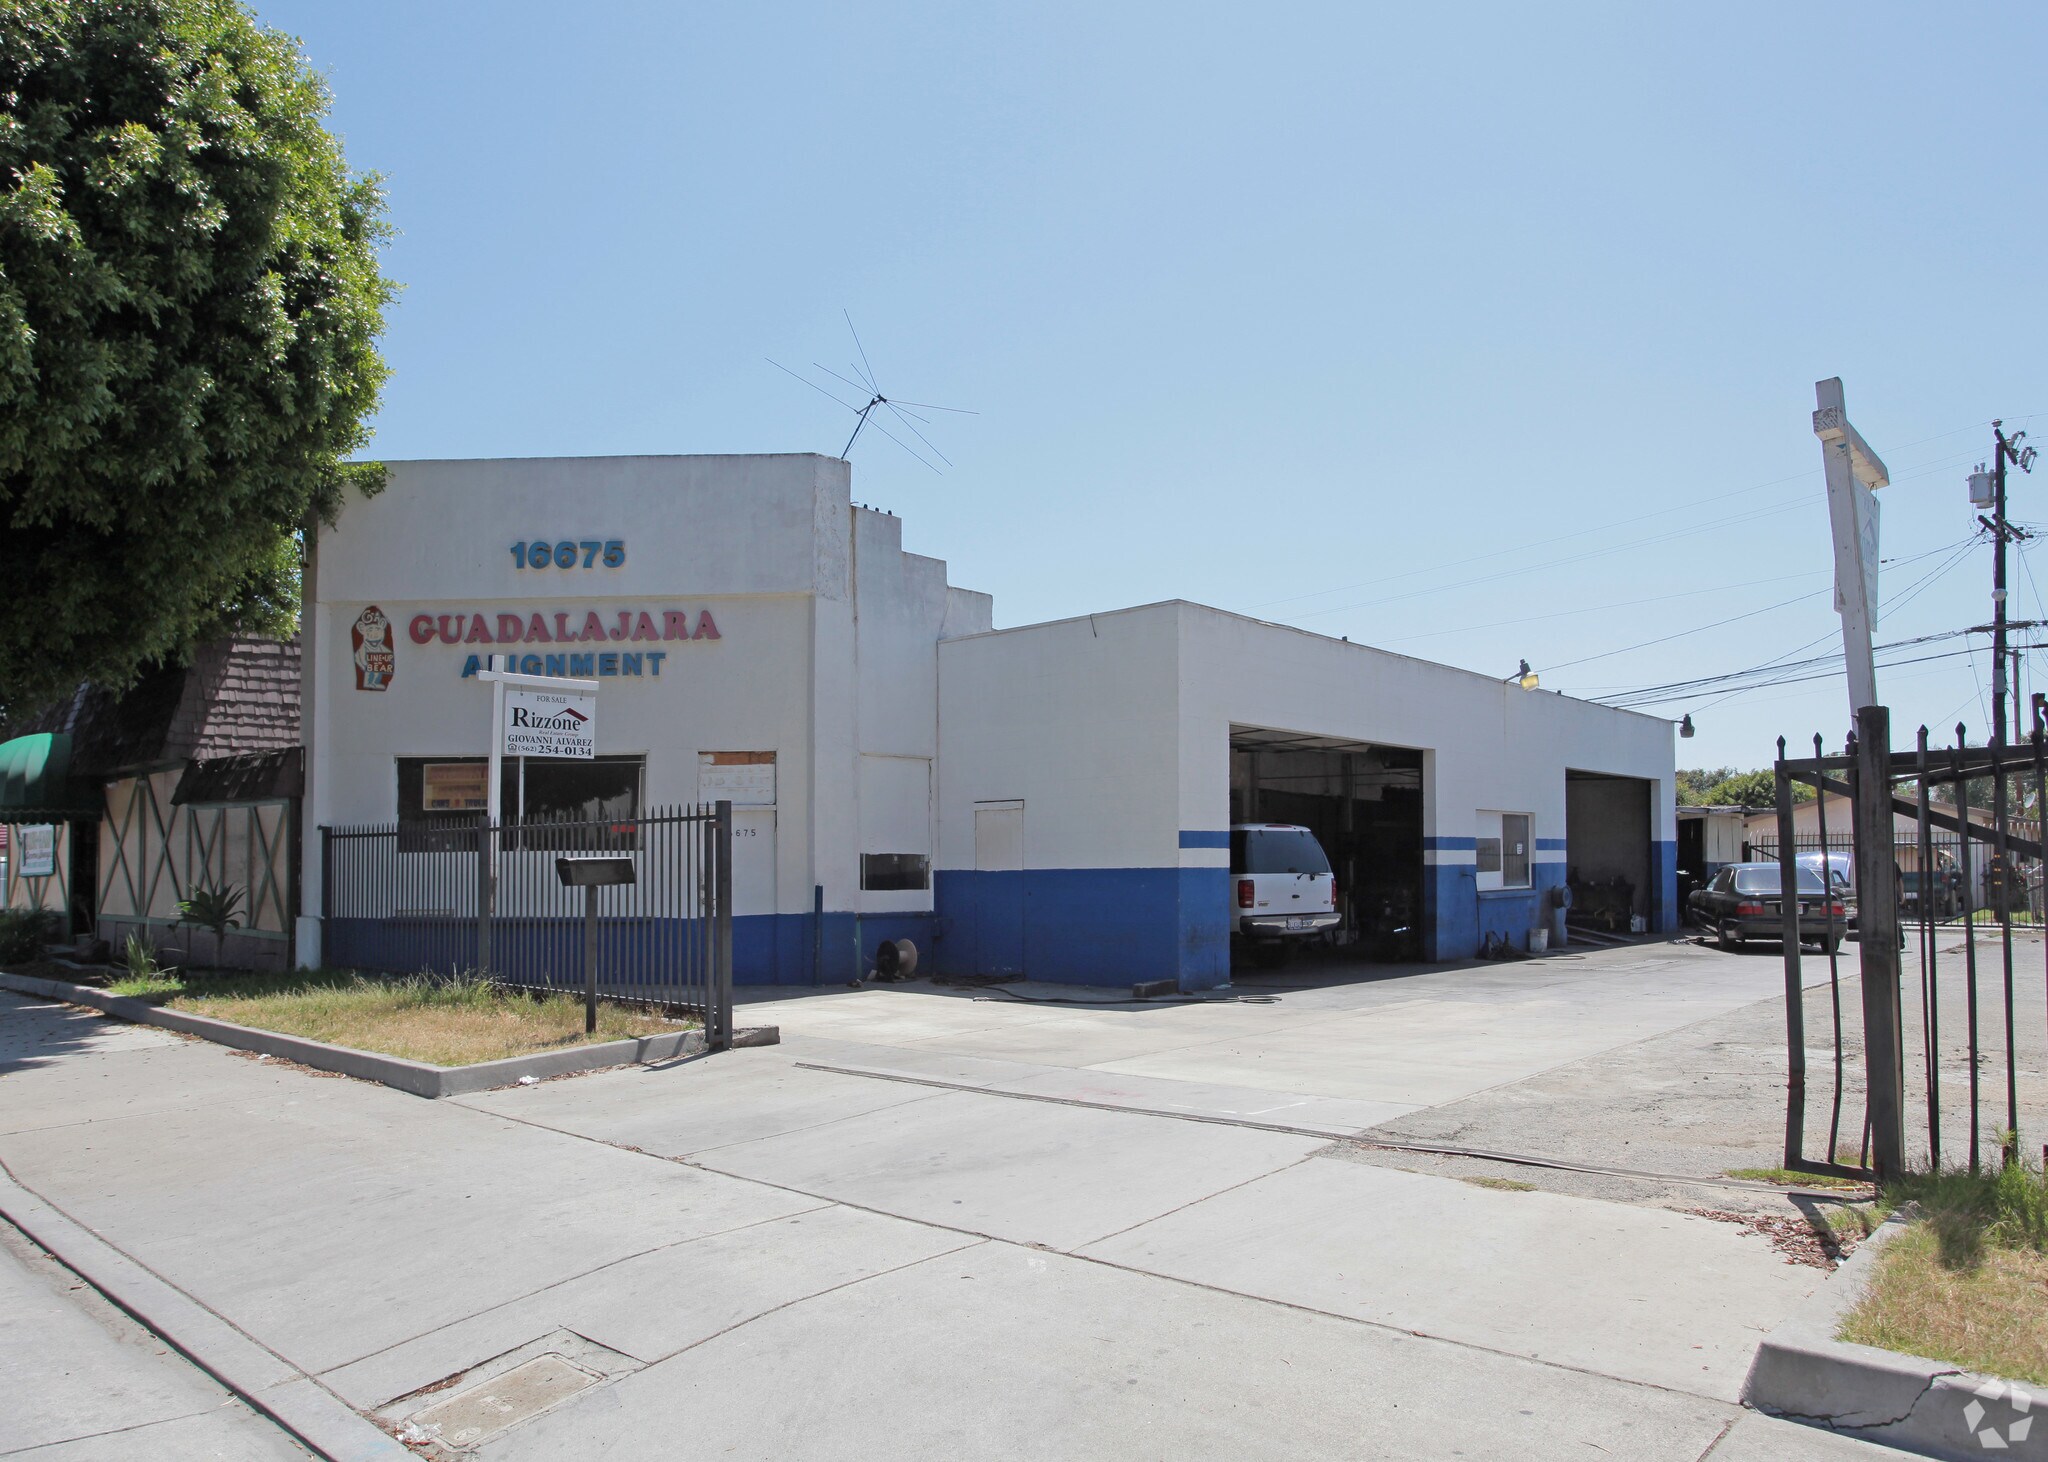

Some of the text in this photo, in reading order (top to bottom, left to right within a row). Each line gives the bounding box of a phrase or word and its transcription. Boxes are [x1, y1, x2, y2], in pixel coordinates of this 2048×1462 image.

[510, 541, 626, 570] 16675
[409, 609, 722, 645] GUADALAJARA
[367, 664, 393, 673] BEAR
[461, 652, 667, 678] AIGNMENT
[536, 695, 567, 704] FOR SALE
[511, 706, 581, 732] Rizzone
[508, 734, 593, 747] GIOVANNI ALVAREZ
[537, 745, 592, 756] 254-0134
